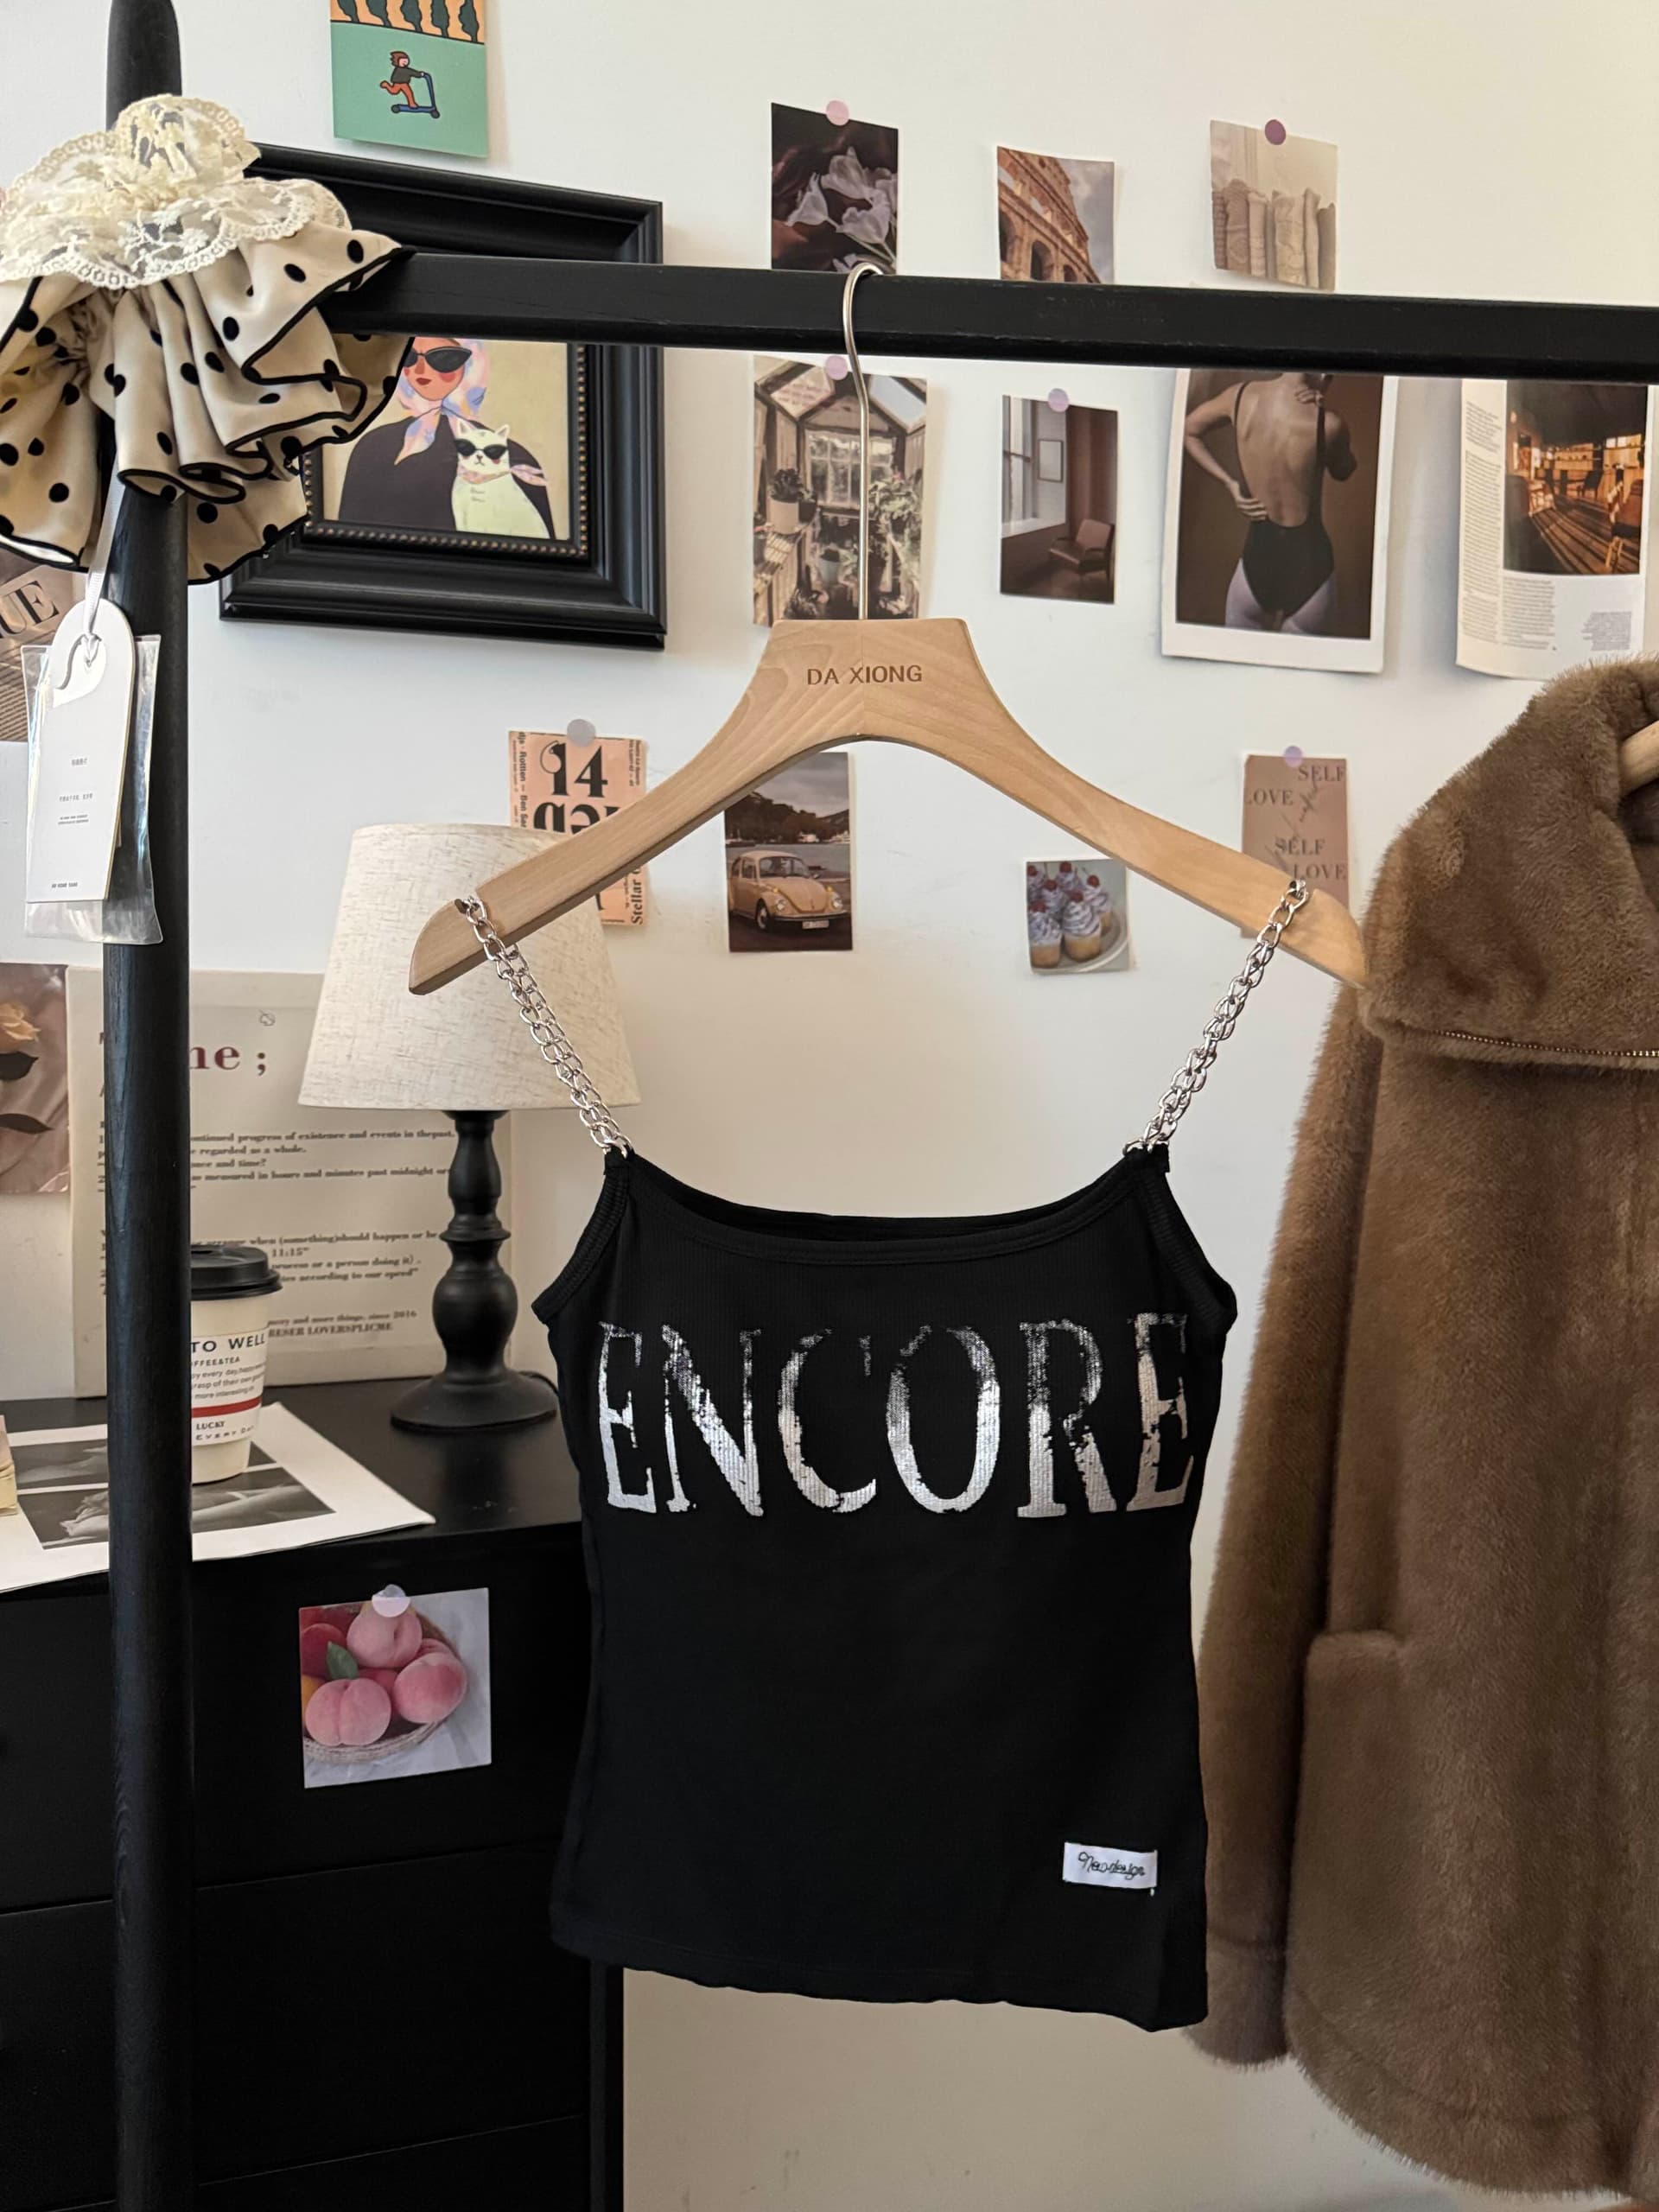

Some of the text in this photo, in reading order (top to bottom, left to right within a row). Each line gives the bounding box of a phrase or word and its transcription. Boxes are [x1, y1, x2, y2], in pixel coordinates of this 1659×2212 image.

[0, 581, 60, 638] UE
[807, 664, 922, 685] DA XIONG
[540, 741, 608, 798] 14
[1298, 764, 1344, 782] SELF
[1274, 838, 1325, 855] SELF
[631, 879, 644, 925] Stellar
[190, 1333, 265, 1353] TO WELL
[191, 1356, 240, 1367] FFEE&TEA
[195, 1421, 226, 1430] LUCKY
[598, 1313, 1194, 1518] ENCORE
